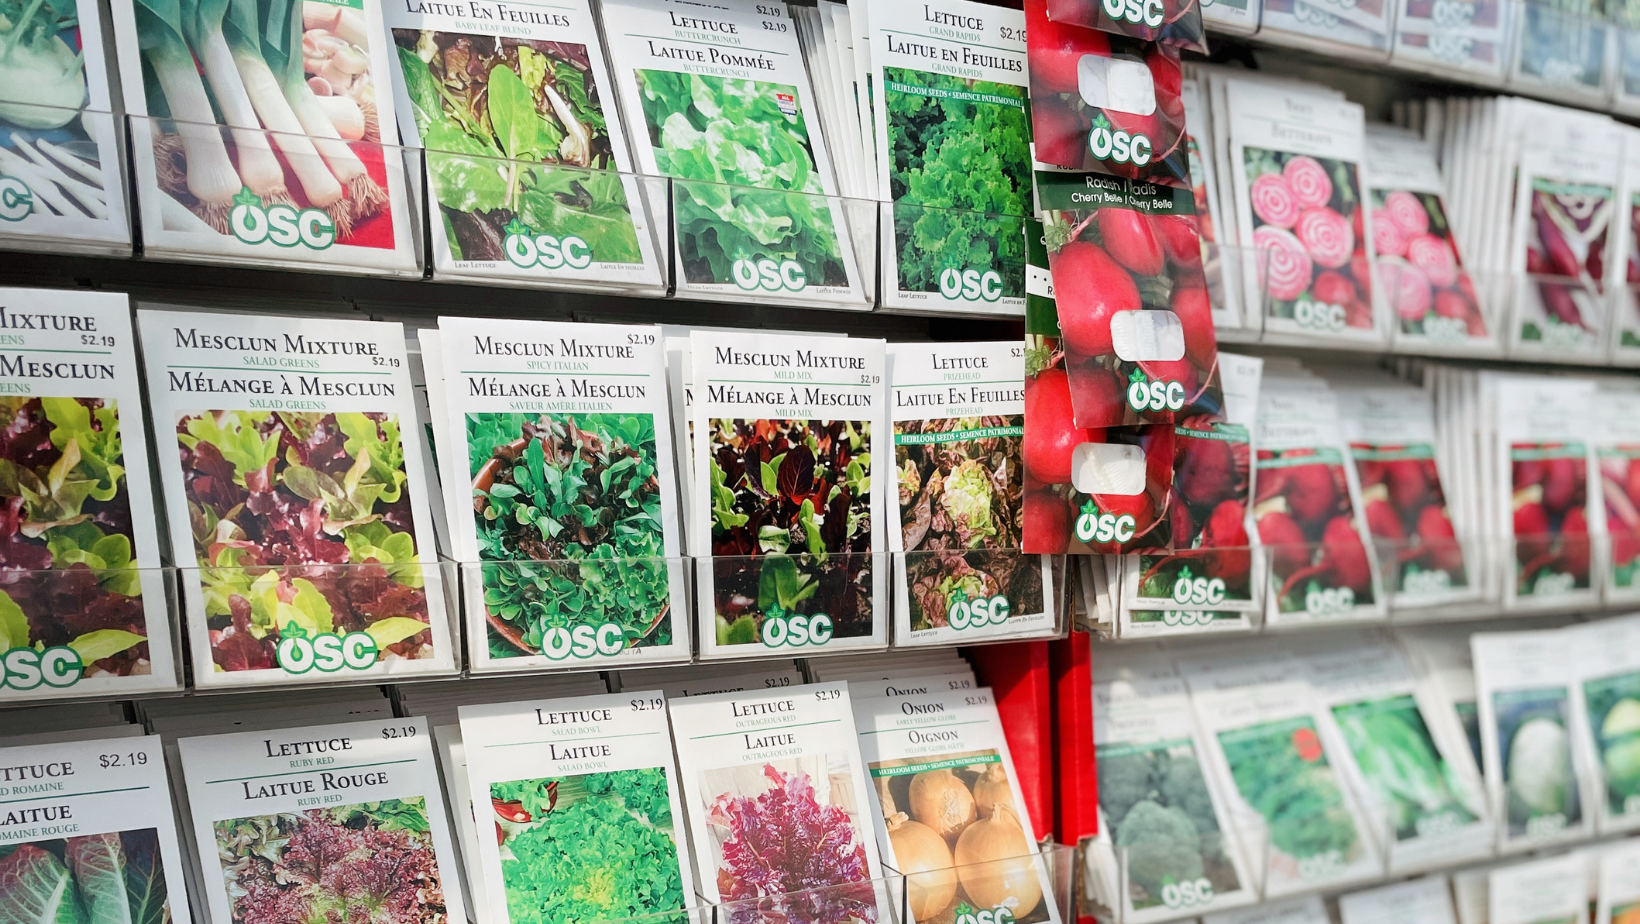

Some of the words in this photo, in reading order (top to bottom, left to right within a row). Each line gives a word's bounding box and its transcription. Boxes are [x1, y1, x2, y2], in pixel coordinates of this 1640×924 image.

[406, 0, 466, 17] LAITUE
[469, 1, 493, 20] EN
[497, 4, 570, 27] FEUILLES
[756, 5, 780, 17] $2.19
[924, 4, 983, 30] LETTUCE
[455, 22, 477, 30] BABY
[480, 23, 500, 32] LEAF
[503, 26, 531, 34] BLEND
[669, 11, 738, 34] LETTUCE
[762, 21, 787, 32] $2.19
[674, 30, 741, 45] BUTTERCRUNCH
[929, 26, 954, 38] GRAND
[955, 31, 981, 42] RAPIDS
[648, 40, 705, 63] LAITUE
[708, 47, 775, 70] POMMÉE
[887, 35, 937, 58] LAITUE
[942, 50, 958, 61] EN
[963, 47, 1022, 72] FEUILLES
[683, 63, 750, 78] BUTTERCRUNCH
[932, 63, 957, 73] GRAND
[958, 67, 983, 78] RAPIDS
[892, 83, 927, 96] HEIRLOOM
[928, 88, 947, 97] SEEDS
[952, 91, 981, 101] SEMENCE
[982, 95, 1023, 107] PATRIMONIAL
[1088, 126, 1152, 168] OSC
[1086, 176, 1120, 190] Radish
[1072, 193, 1102, 203] Cherry
[1104, 193, 1122, 202] Belle
[1153, 200, 1172, 208] Belle
[229, 200, 336, 250] OSC
[503, 232, 593, 269] OSC
[732, 258, 806, 291] OSC
[940, 267, 1003, 302] OSC
[81, 334, 115, 346] $2.19
[174, 327, 277, 352] MESCLUN
[282, 334, 379, 356] MIXTURE
[474, 335, 554, 356] MESCLUN
[560, 339, 634, 359] MIXTURE
[627, 333, 655, 346] $2.19
[243, 356, 277, 367] SALAD
[280, 358, 320, 368] GREENS
[372, 356, 400, 367] $2.19
[527, 360, 552, 370] SPICY
[554, 361, 589, 370] ITALIAN
[715, 346, 790, 366] MESCLUN
[796, 350, 865, 369] MIXTURE
[932, 354, 988, 370] LETTUCE
[0, 354, 114, 380] MESCLUN
[774, 371, 795, 379] MILD
[797, 372, 813, 380] MIX
[861, 374, 880, 384] $2.19
[943, 372, 981, 381] PRIZEHEAD
[167, 371, 274, 394] MÉLANGE
[280, 375, 293, 395] À
[299, 376, 395, 397] MESCLUN
[468, 377, 551, 397] MÉLANGE
[556, 378, 566, 397] À
[571, 379, 646, 398] MESCLUN
[249, 398, 283, 409] SALAD
[286, 400, 326, 410] GREENS
[707, 385, 784, 404] MÉLANGE
[790, 387, 799, 405] À
[804, 388, 871, 407] MESCLUN
[897, 390, 944, 407] LAITUE
[948, 388, 966, 404] EN
[971, 387, 1025, 403] FEUILLES
[1127, 380, 1186, 412] OSC
[510, 401, 544, 410] SAVEUR
[546, 400, 577, 410] AMÈRE
[578, 401, 612, 411] ITALIEN
[775, 409, 795, 417] MILD
[797, 409, 813, 417] MIX
[946, 407, 983, 416] PRIZEHEAD
[901, 434, 935, 443] HEIRLOOM
[937, 432, 955, 441] SEEDS
[960, 428, 987, 439] SEMENCE
[988, 427, 1024, 436] PATRIMONIAL
[1075, 511, 1137, 544] OSC
[1174, 577, 1226, 606] OSC
[948, 594, 1010, 630] OSC
[761, 613, 833, 648] OSC
[541, 620, 625, 661] OSC
[276, 632, 378, 675] OSC
[0, 645, 84, 691] SC
[765, 677, 790, 688] $2.19
[949, 680, 970, 690] $2.19
[815, 690, 840, 701] $2.19
[965, 696, 988, 706] $2.19
[630, 698, 663, 712] $2.19
[731, 700, 795, 717] LETTUCE
[902, 702, 944, 715] ONION
[535, 708, 612, 726] LETTUCE
[736, 716, 782, 728] OUTRAGEOUS
[783, 714, 796, 722] RED
[915, 716, 936, 724] YELLOW
[938, 714, 957, 722] GLOBE
[381, 726, 417, 740] $2.19
[552, 728, 576, 736] SALAD
[578, 726, 602, 735] BOWL
[908, 730, 959, 744] OIGNON
[264, 737, 352, 758] LETTUCE
[744, 733, 796, 749] LAITUE
[99, 752, 147, 769] $2.19
[549, 744, 611, 761] LAITUE
[742, 749, 787, 761] OUTRAGEOUS
[789, 747, 803, 755] RED
[290, 757, 313, 768] RUBY
[316, 756, 335, 766] RED
[558, 764, 583, 772] SALAD
[585, 761, 608, 770] BOWL
[879, 765, 910, 775] HEIRLOOM
[0, 762, 75, 782] TTUCE
[12, 782, 64, 795] ROMAINE
[242, 780, 315, 800] LAITUE
[320, 771, 389, 791] ROUGE
[297, 796, 322, 806] RUBY
[324, 794, 342, 804] RED
[0, 830, 39, 840] MAINE
[41, 824, 79, 836] ROUGE
